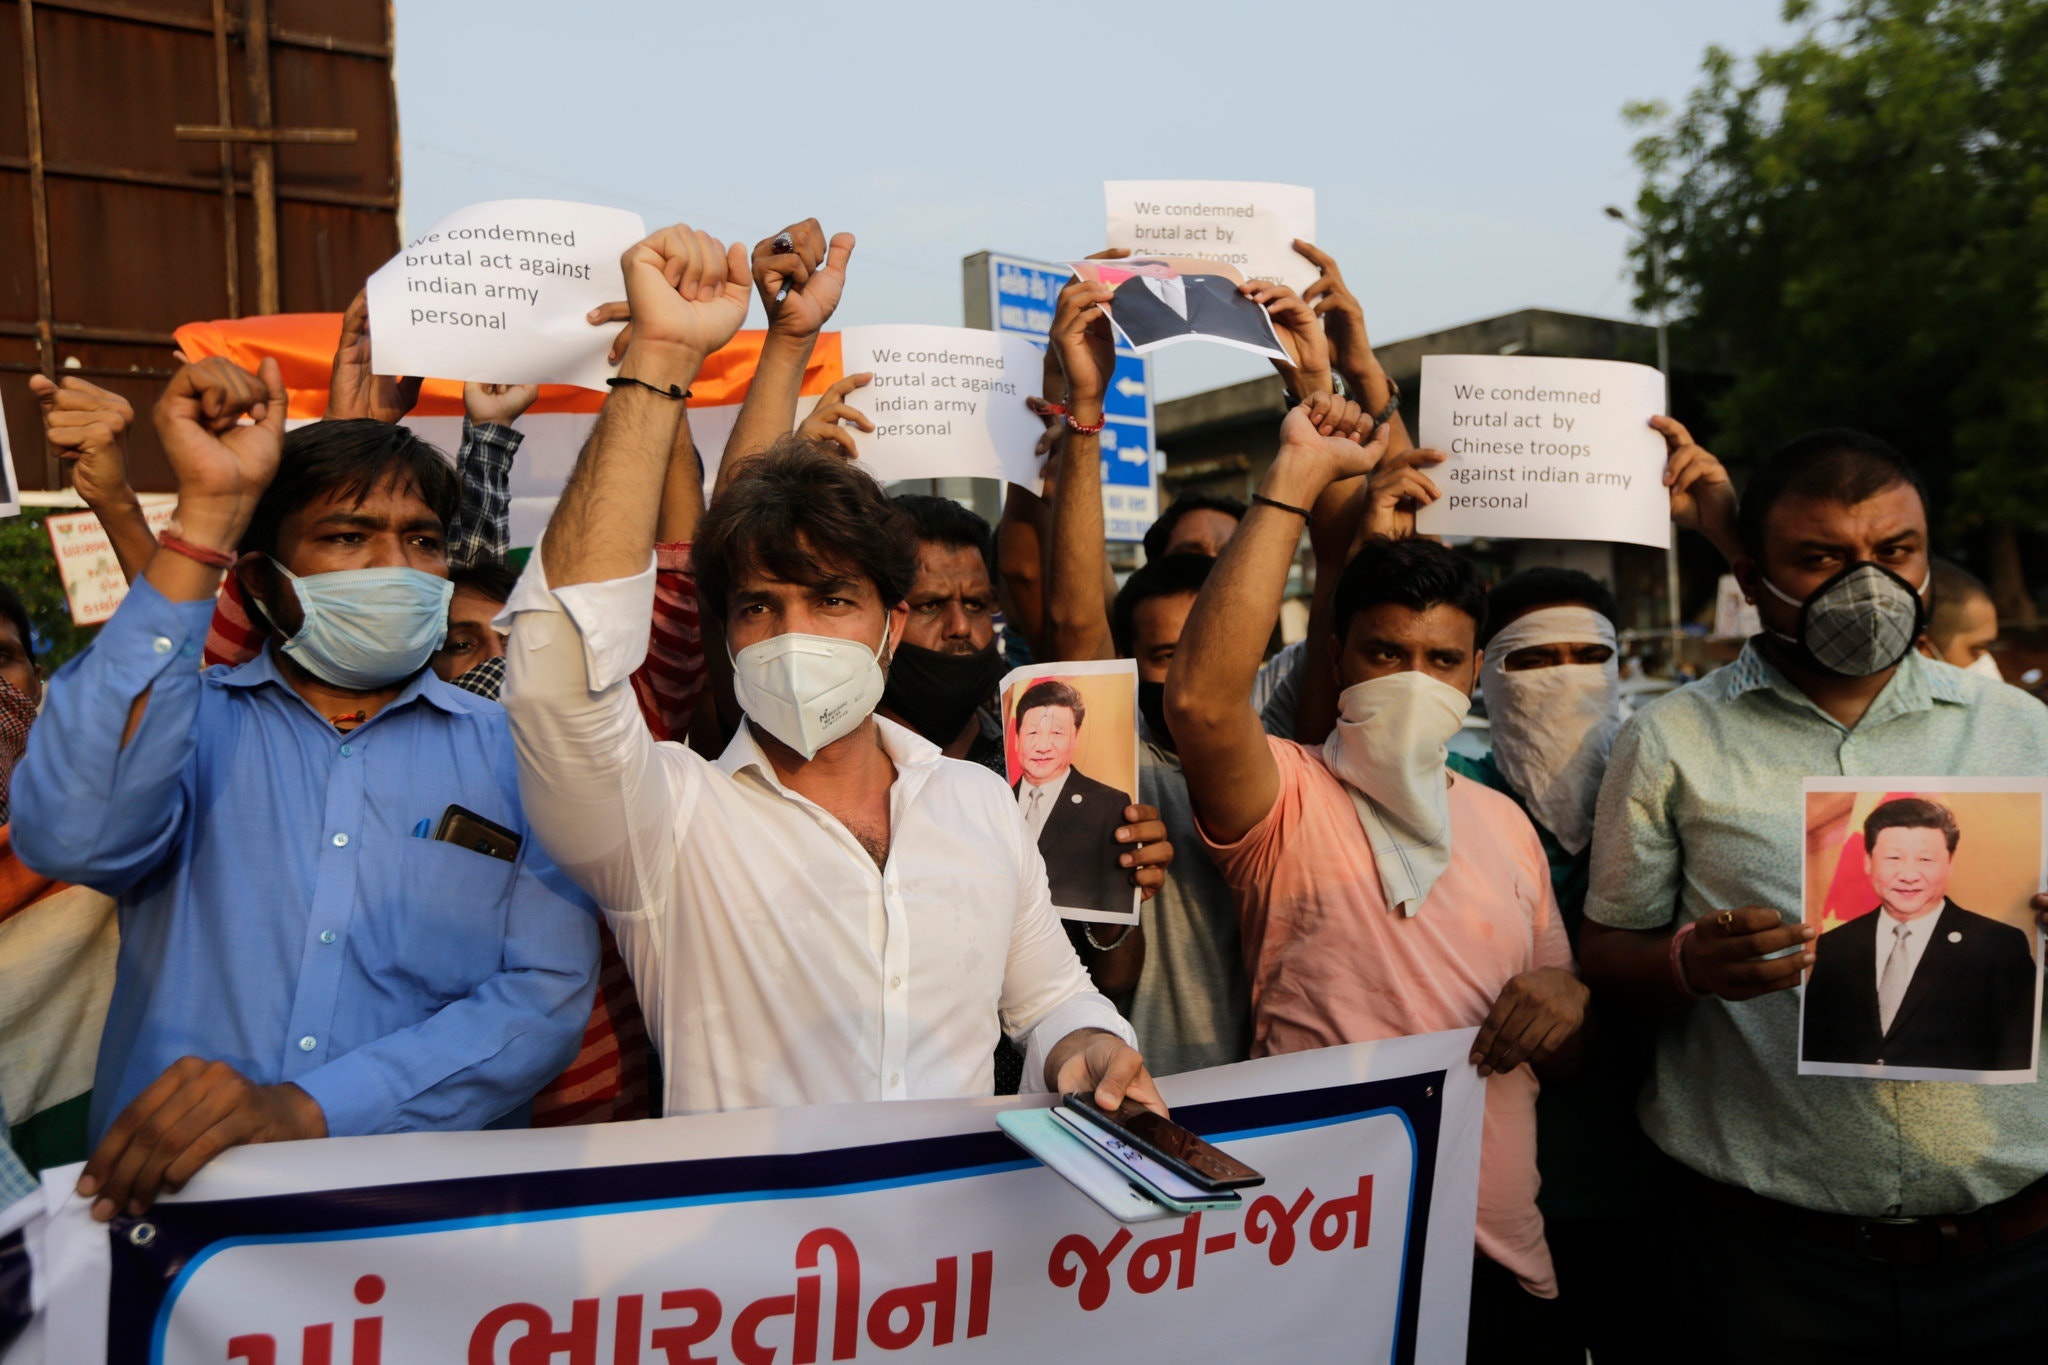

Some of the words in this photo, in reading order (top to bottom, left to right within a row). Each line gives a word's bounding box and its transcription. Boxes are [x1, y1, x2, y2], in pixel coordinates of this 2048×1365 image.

[1134, 201, 1161, 215] We
[1165, 203, 1254, 218] condemned
[447, 224, 576, 247] condemned
[1135, 224, 1180, 240] brutal
[1184, 229, 1206, 240] act
[1216, 226, 1234, 243] by
[406, 250, 472, 267] brutal
[480, 254, 513, 270] act
[519, 258, 591, 280] against
[407, 277, 477, 296] indian
[484, 284, 539, 306] army
[411, 308, 506, 330] personal
[872, 349, 901, 363] We
[907, 349, 1005, 369] condemned
[874, 372, 925, 387] brutal
[931, 375, 957, 388] act
[961, 377, 1017, 395] against
[875, 396, 928, 412] indian
[934, 399, 977, 415] army
[1454, 385, 1485, 400] We
[1491, 386, 1601, 405] condemned
[876, 421, 952, 439] personal
[1453, 411, 1508, 427] brutal
[1513, 414, 1542, 428] act
[1553, 413, 1575, 432] by
[1451, 438, 1524, 455] Chinese
[1530, 441, 1591, 459] troops
[1450, 465, 1516, 485] against
[1522, 466, 1579, 484] indian
[1585, 472, 1632, 490] army
[1449, 493, 1528, 510] personal
[1048, 1174, 1374, 1312] જન-જન
